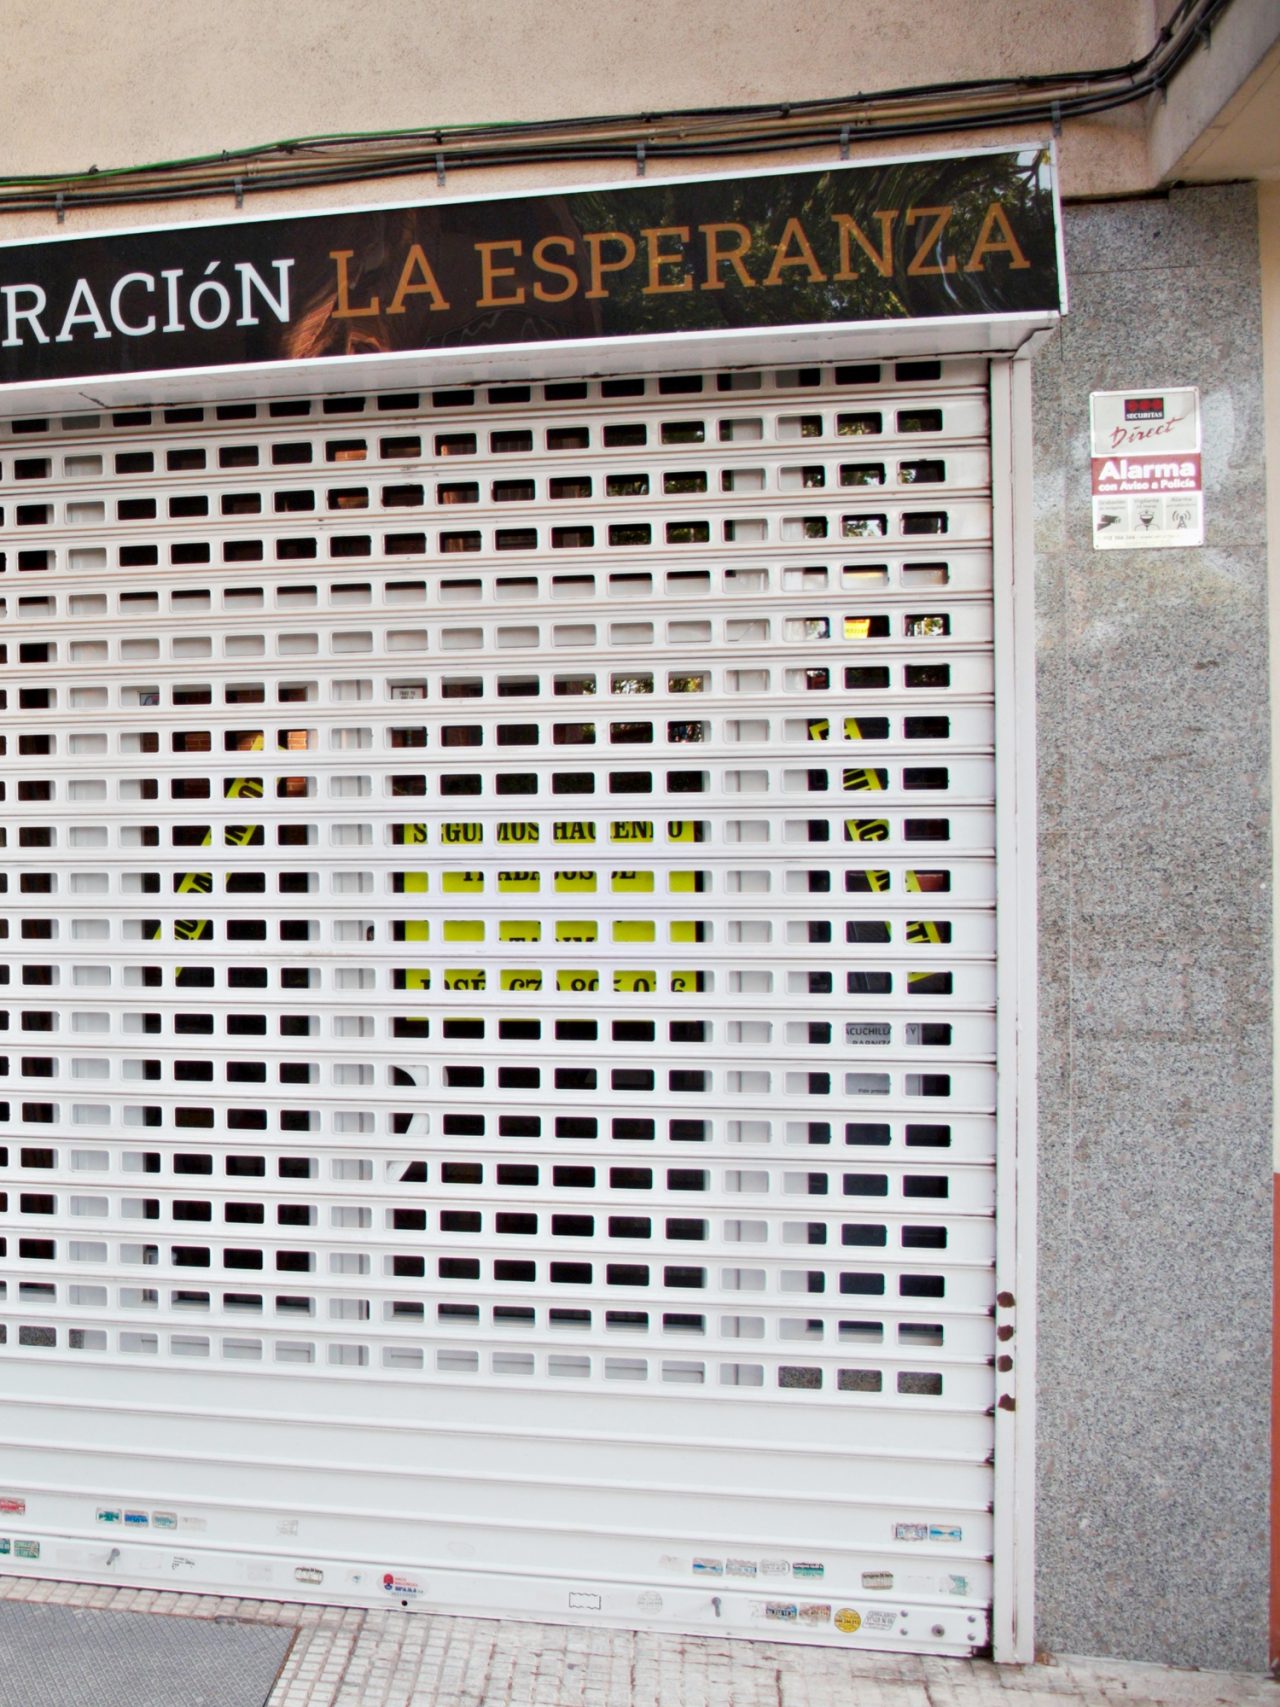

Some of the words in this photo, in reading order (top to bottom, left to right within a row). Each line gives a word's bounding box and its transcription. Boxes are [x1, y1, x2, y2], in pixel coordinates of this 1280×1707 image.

[329, 244, 450, 318] LA
[475, 202, 1030, 308] ESPERANZA
[1098, 459, 1196, 481] Alarma
[1098, 483, 1118, 492] con
[1120, 481, 1149, 491] Aviso
[1151, 482, 1159, 490] a
[1160, 478, 1196, 490] Policía
